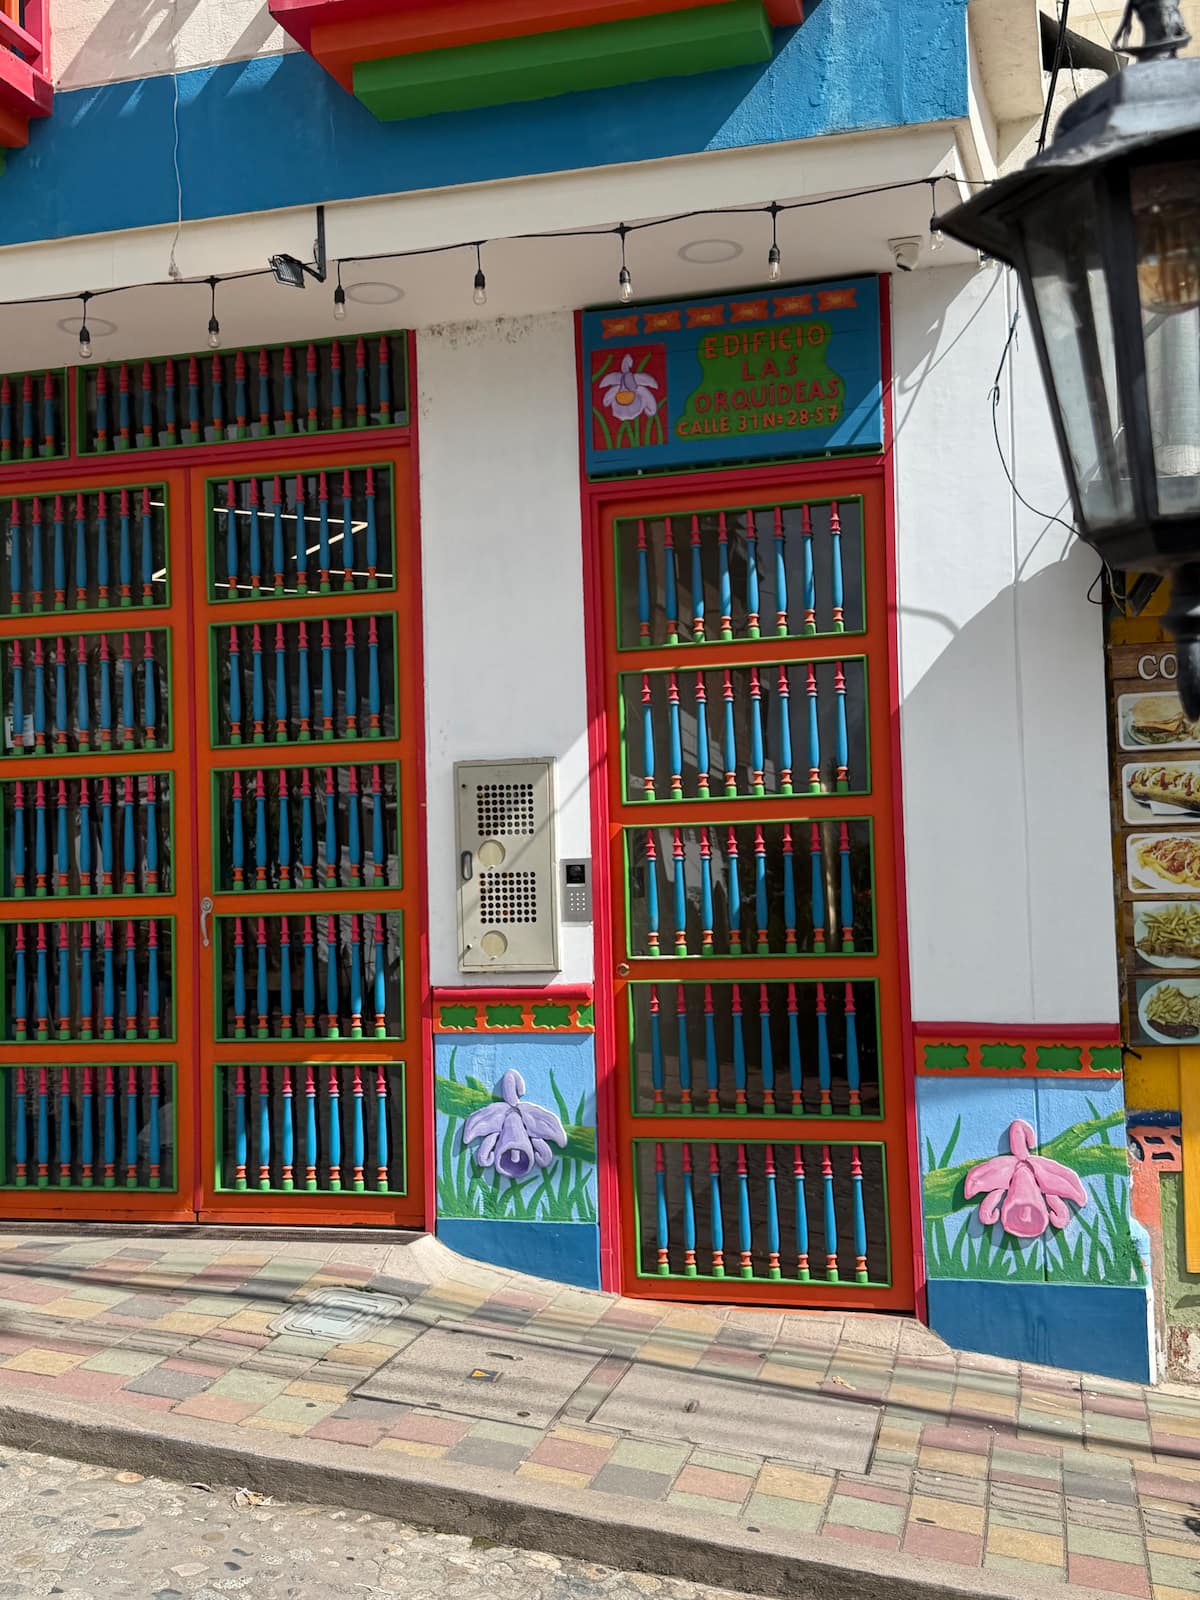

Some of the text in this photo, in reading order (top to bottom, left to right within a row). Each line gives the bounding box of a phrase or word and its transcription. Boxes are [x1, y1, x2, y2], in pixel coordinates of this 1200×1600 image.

[704, 326, 825, 359] EDIFICIO
[742, 355, 799, 381] LAS
[677, 417, 730, 436] CALLE
[787, 405, 838, 426] 28-57
